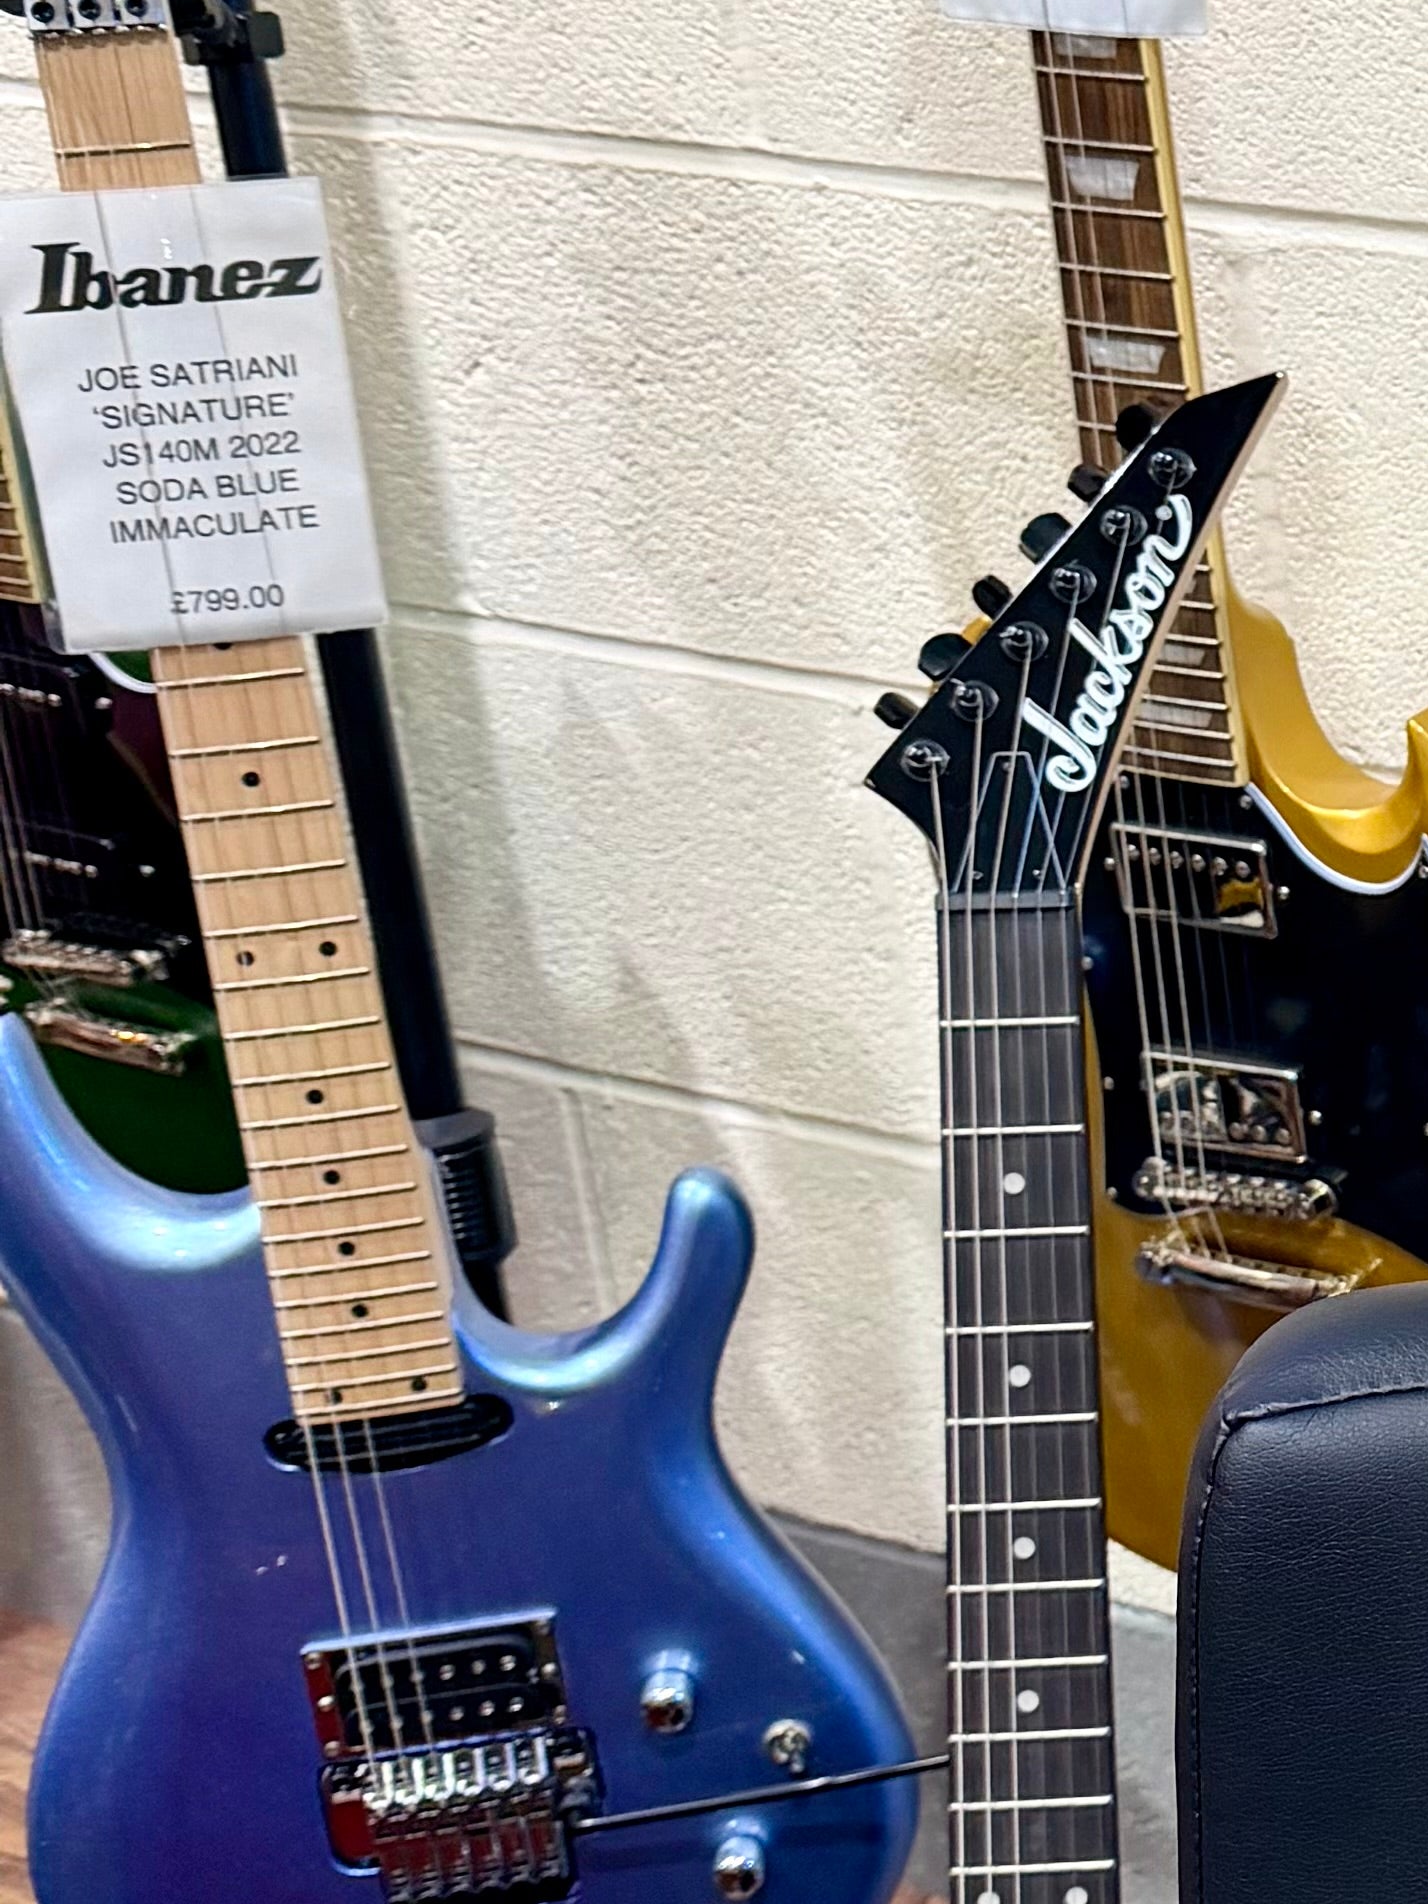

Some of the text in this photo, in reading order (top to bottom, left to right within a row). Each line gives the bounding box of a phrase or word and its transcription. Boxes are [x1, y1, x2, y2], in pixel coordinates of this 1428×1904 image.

[23, 242, 323, 315] Ibanez
[77, 353, 299, 393] JOE SATRIANI
[102, 431, 302, 469] JS140M 2022
[116, 468, 301, 505] SODA BLUE
[109, 504, 320, 544] IMMACULATE
[171, 584, 285, 615] £799.00
[1022, 494, 1194, 793] Jackson
